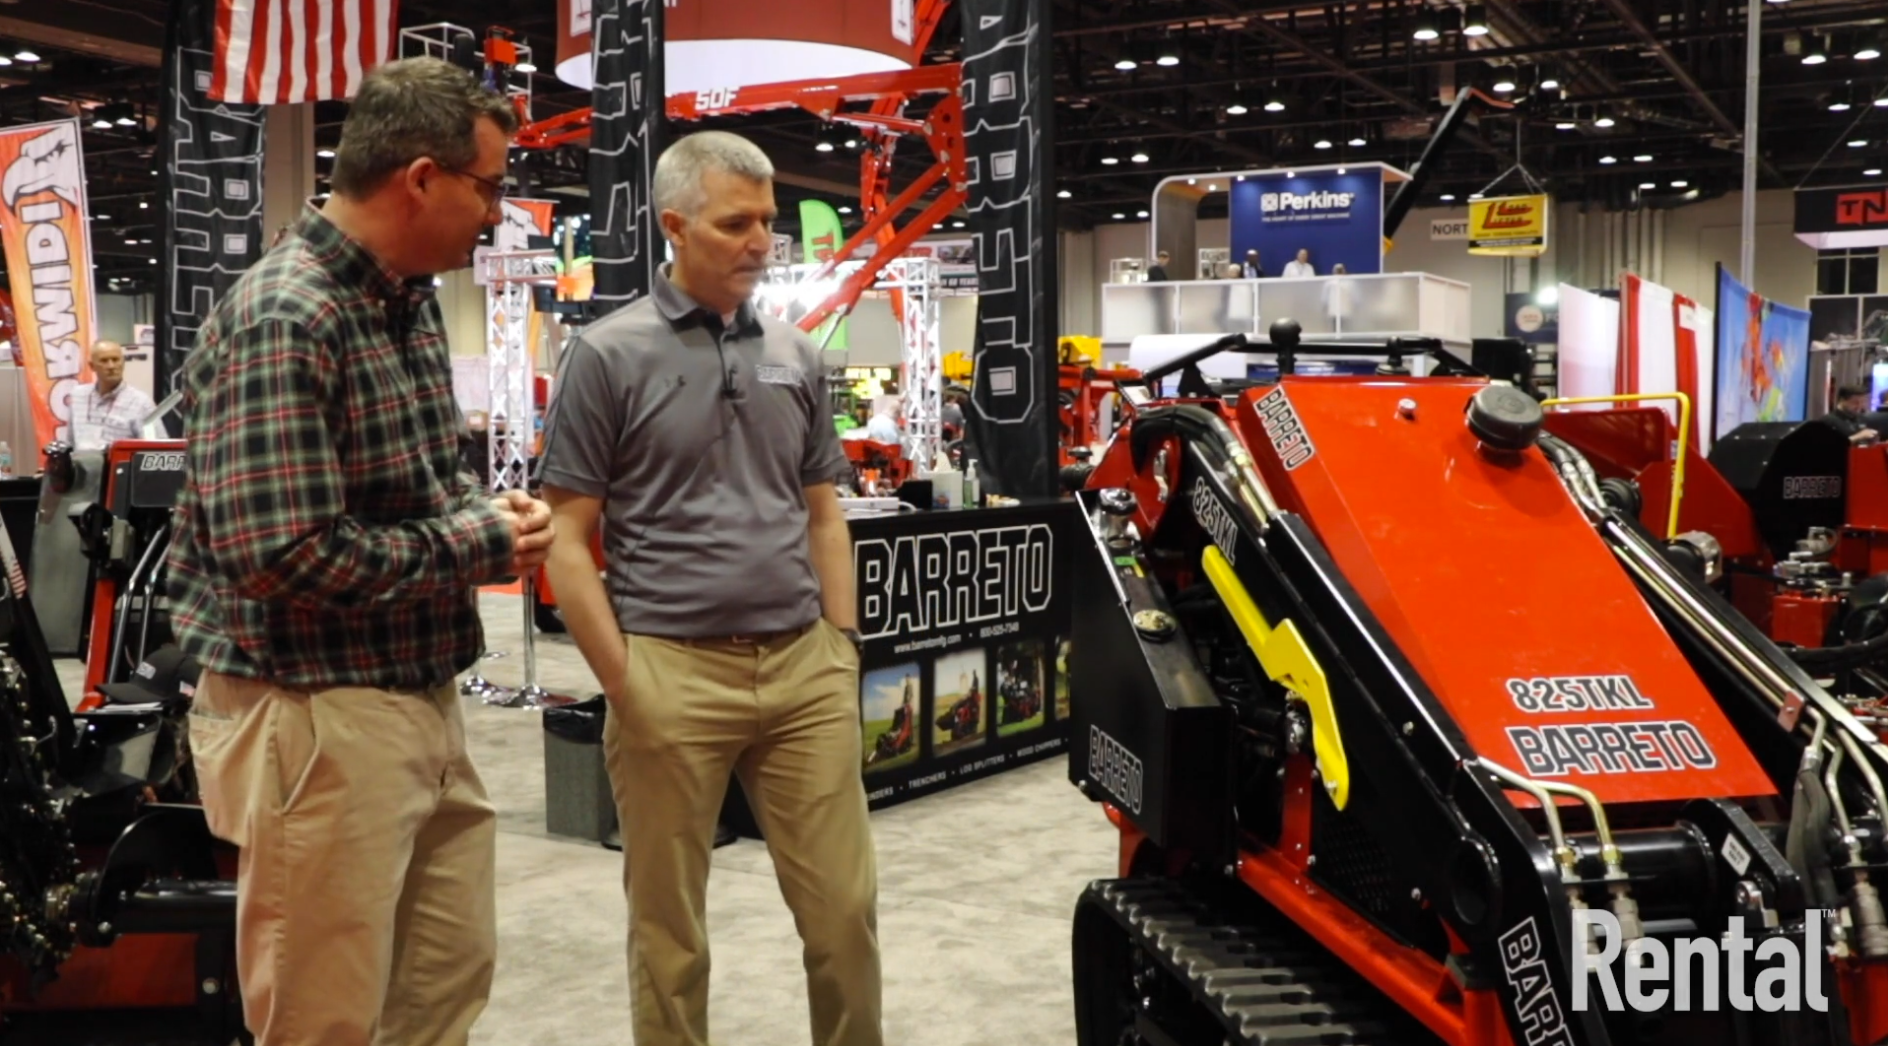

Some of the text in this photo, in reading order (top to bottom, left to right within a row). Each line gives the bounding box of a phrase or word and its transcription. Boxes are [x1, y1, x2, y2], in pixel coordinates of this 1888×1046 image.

[1280, 190, 1350, 210] Perkins
[1252, 384, 1316, 472] BARRETO
[1193, 476, 1238, 567] 825TKL
[1783, 476, 1841, 499] BARRETO
[854, 523, 1053, 640] BARRETO
[1506, 675, 1654, 713] 825TKL
[1088, 724, 1143, 815] BARRETO
[1505, 720, 1716, 777] BARRETO
